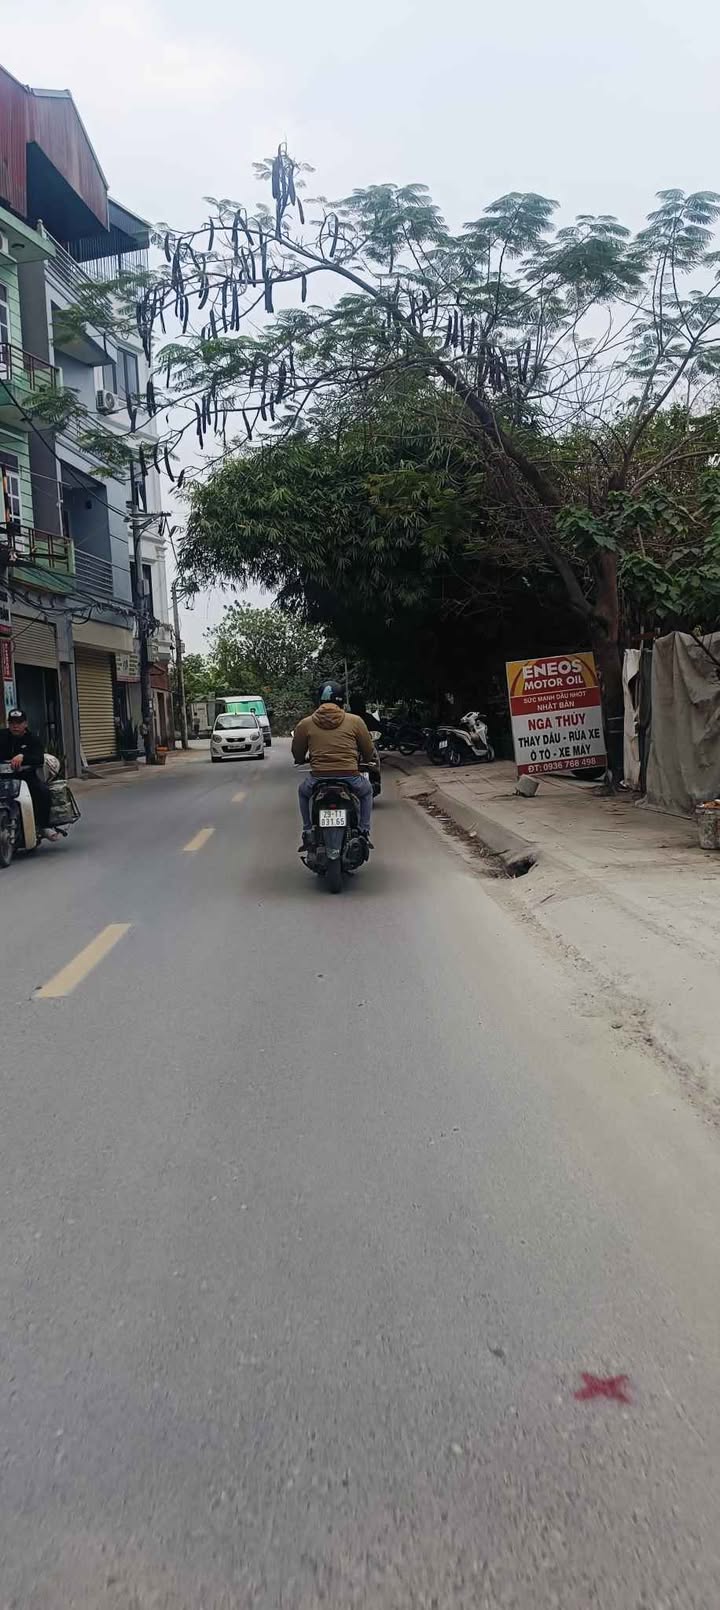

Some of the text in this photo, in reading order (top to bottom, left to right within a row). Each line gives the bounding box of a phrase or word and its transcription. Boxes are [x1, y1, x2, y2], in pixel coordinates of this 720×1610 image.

[522, 659, 583, 678] ENEOS
[524, 675, 584, 691] MOTOR OIL
[527, 717, 553, 731] NGA
[518, 734, 540, 748] THAY
[588, 728, 600, 739] XE
[559, 746, 571, 758] XE
[528, 765, 542, 773] ĐT:
